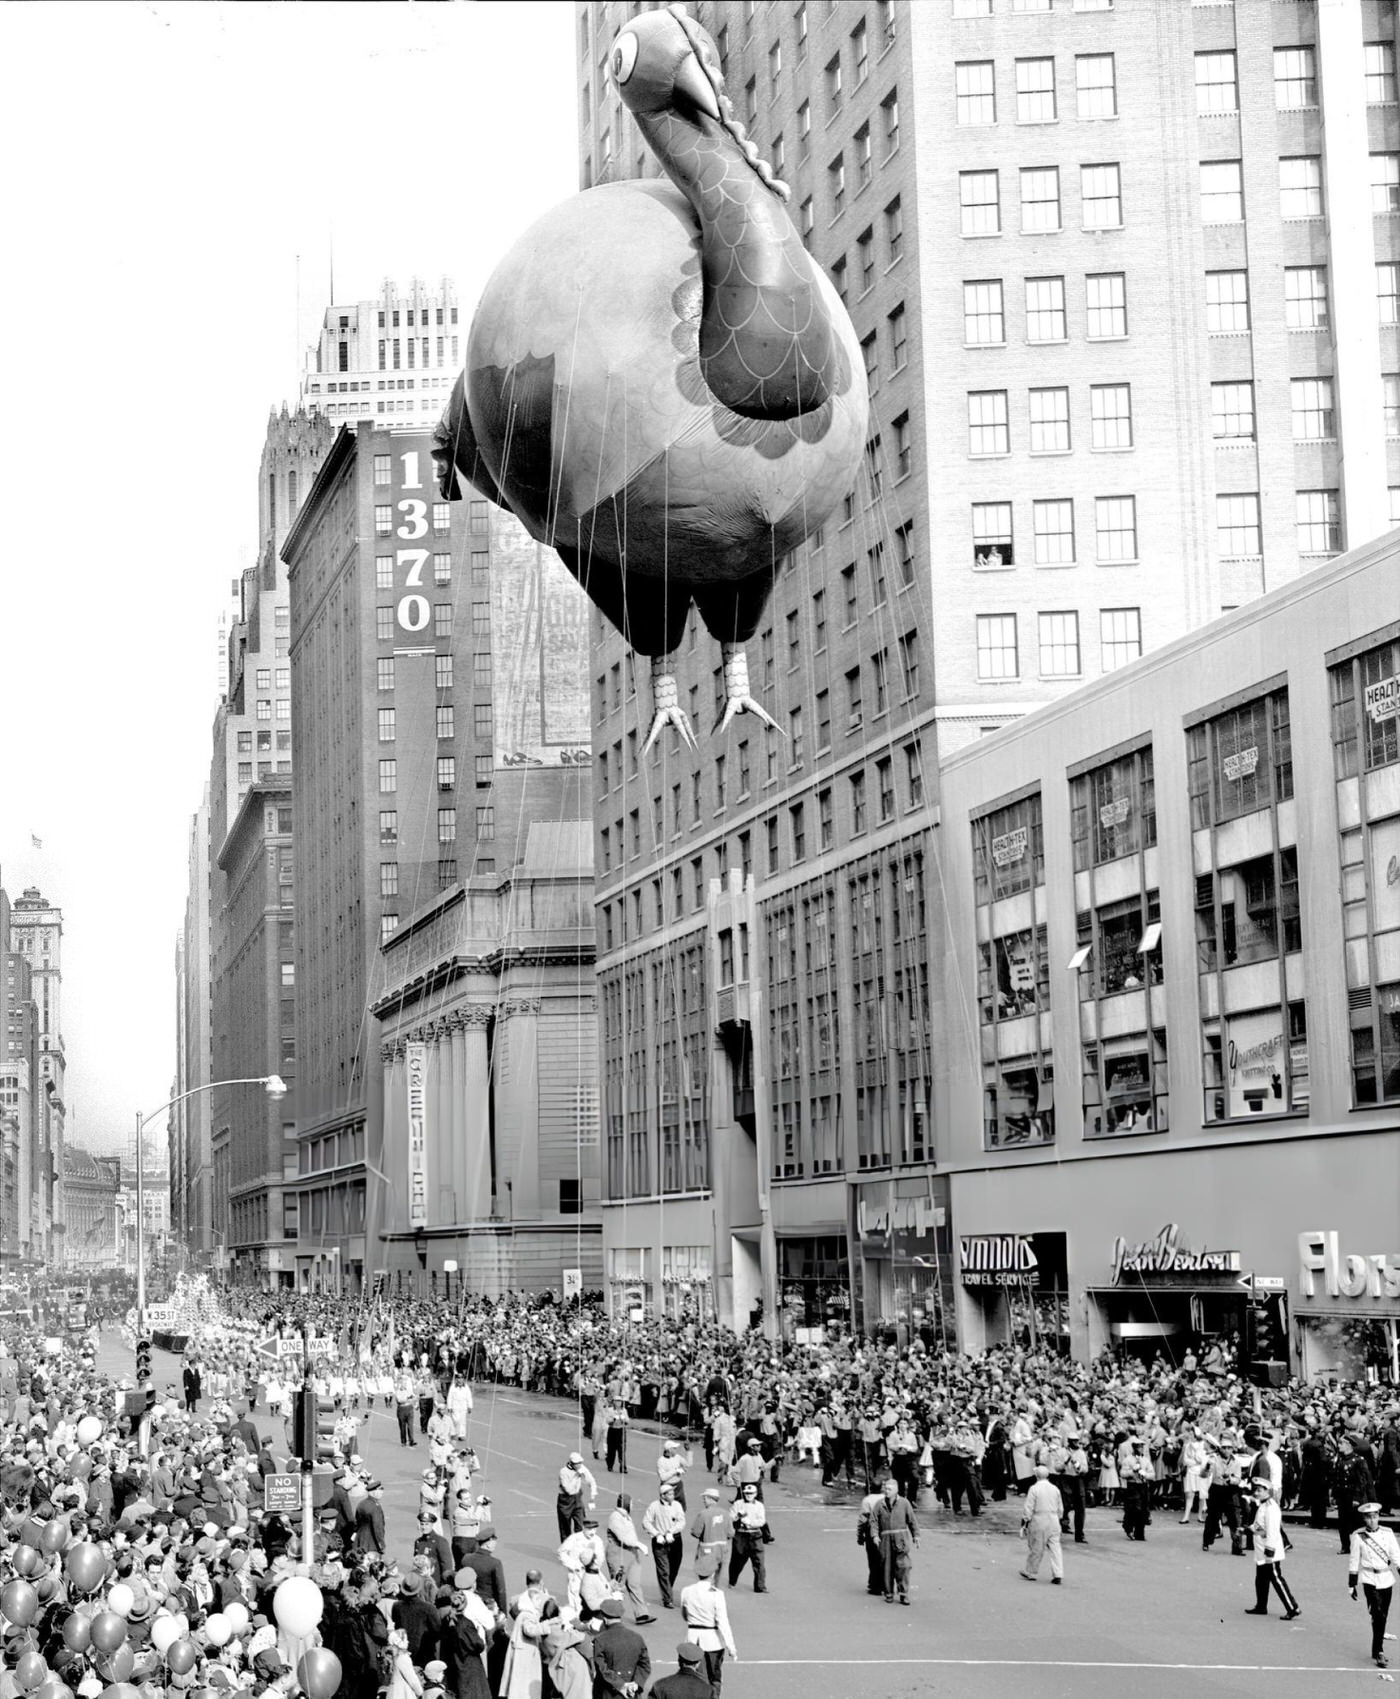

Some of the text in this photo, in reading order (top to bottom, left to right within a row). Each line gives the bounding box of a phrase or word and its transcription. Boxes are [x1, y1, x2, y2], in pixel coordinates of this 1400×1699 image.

[397, 452, 431, 632] 1370
[961, 1271, 1040, 1286] TRAVEL SERVICE
[154, 1310, 166, 1320] 35
[281, 1340, 329, 1352] ONE WAY
[275, 1477, 292, 1487] NO
